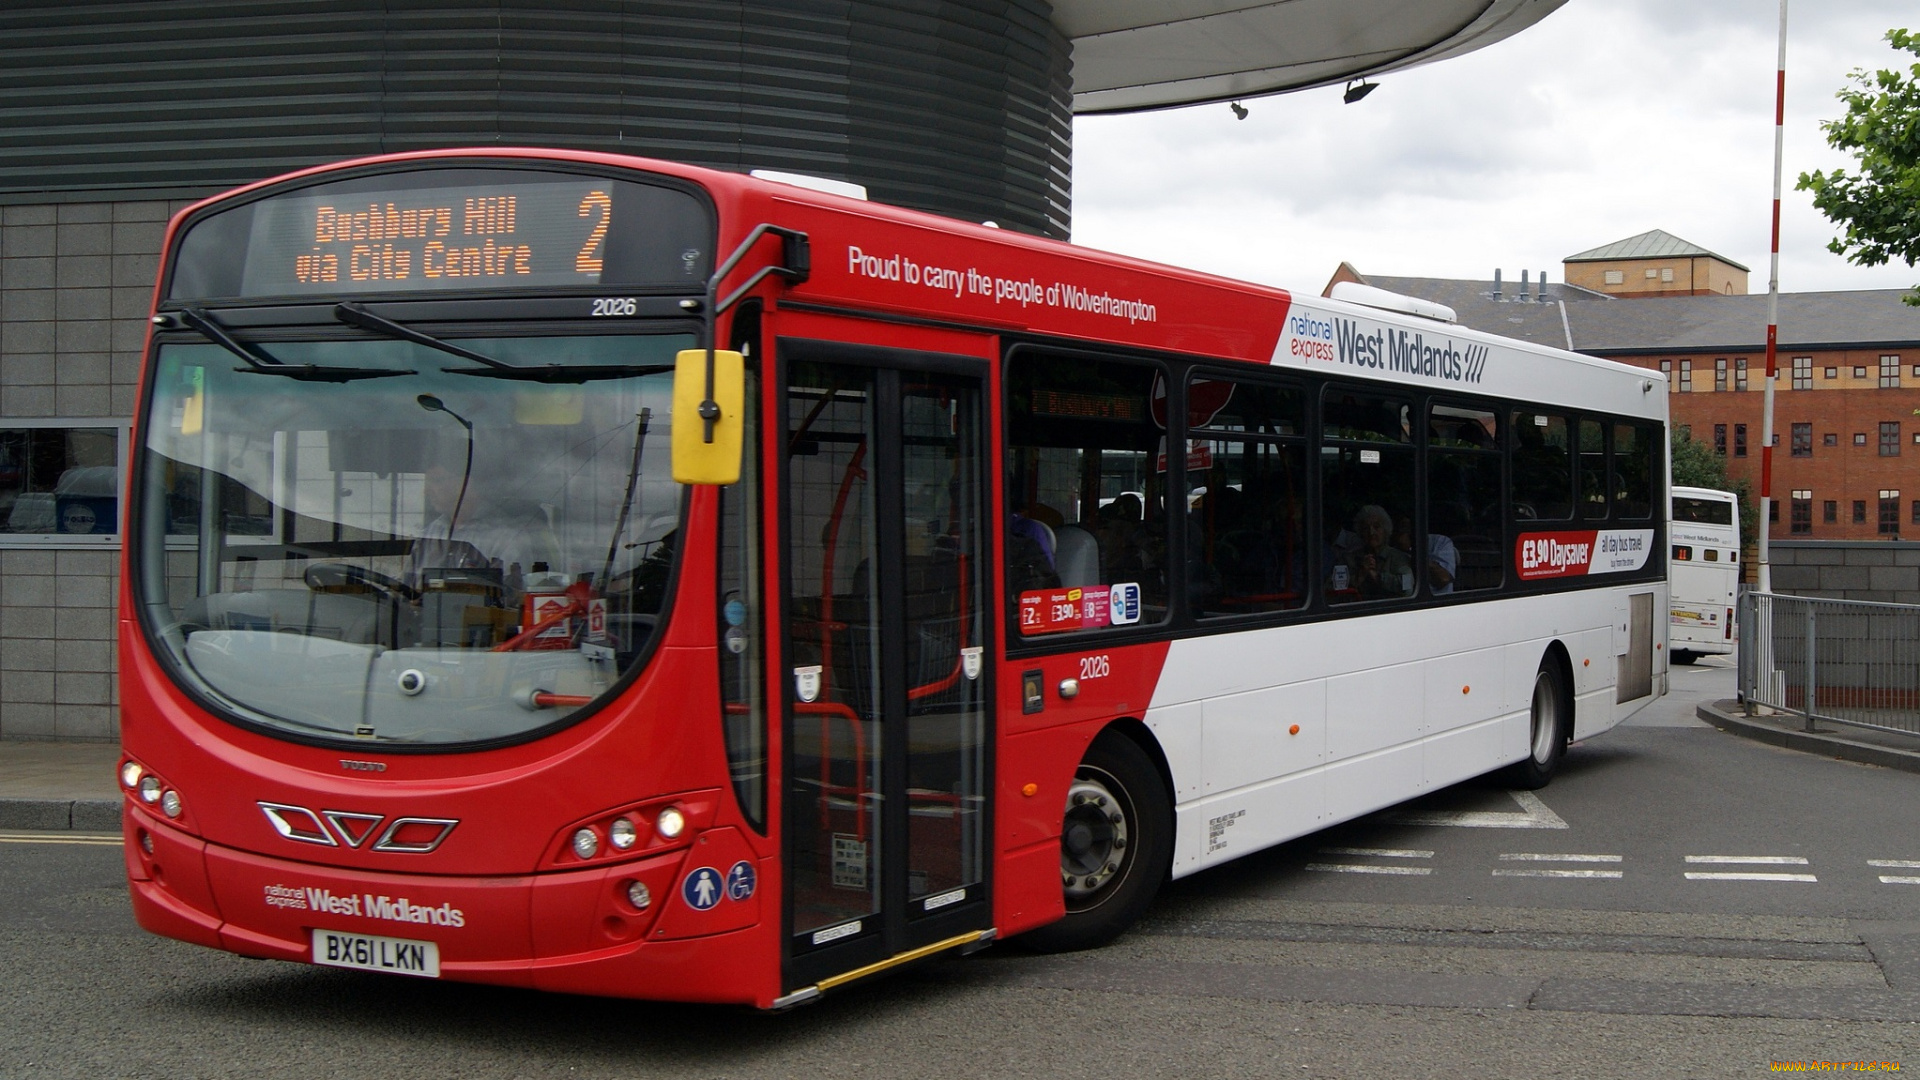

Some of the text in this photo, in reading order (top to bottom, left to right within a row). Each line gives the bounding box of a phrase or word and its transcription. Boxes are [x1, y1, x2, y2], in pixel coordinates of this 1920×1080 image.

[315, 196, 516, 243] Bushbury Hill
[575, 191, 612, 272] 2
[296, 238, 531, 283] via City Centre
[848, 246, 1156, 325] Proud to carry the people of Wolverhampton
[592, 298, 637, 316] 2026
[1290, 312, 1333, 341] national
[1290, 337, 1333, 364] express
[1335, 317, 1461, 381] West Midlands
[1522, 539, 1589, 572] £3.90 Daysaver
[1609, 535, 1618, 556] day
[1619, 534, 1628, 552] bus
[1628, 534, 1642, 551] travel
[1080, 655, 1110, 680] 2026
[338, 760, 387, 772] VOLVO
[264, 884, 305, 899] national
[266, 895, 307, 909] express
[306, 887, 465, 928] West Midlands
[326, 934, 425, 971] BX61 LKN
